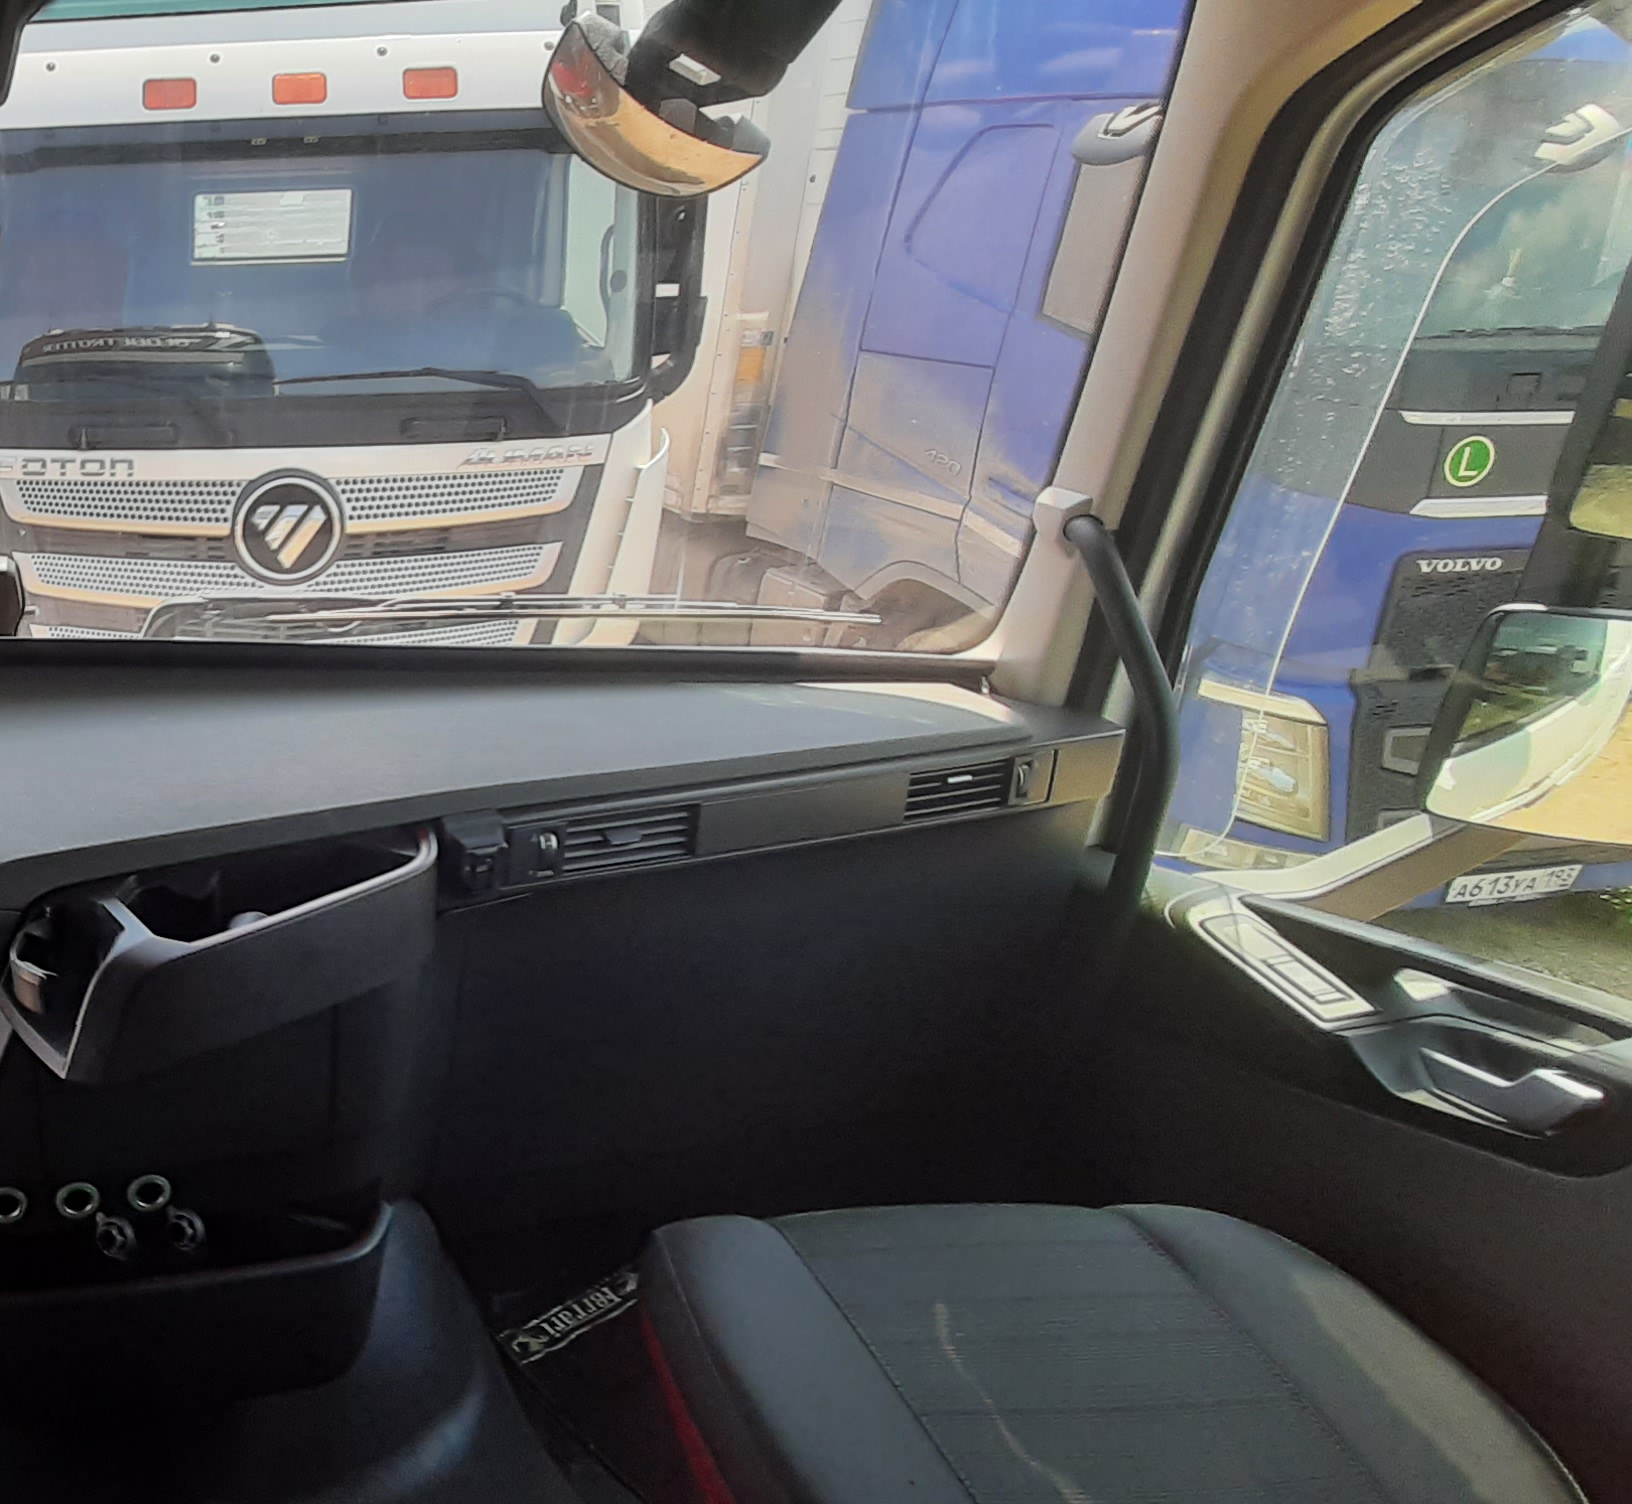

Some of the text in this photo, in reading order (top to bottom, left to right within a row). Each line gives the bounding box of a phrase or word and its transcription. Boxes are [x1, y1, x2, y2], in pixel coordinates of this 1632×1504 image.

[1457, 446, 1479, 477] L
[1416, 556, 1504, 573] VOLVO
[540, 1286, 623, 1338] Ferrari
